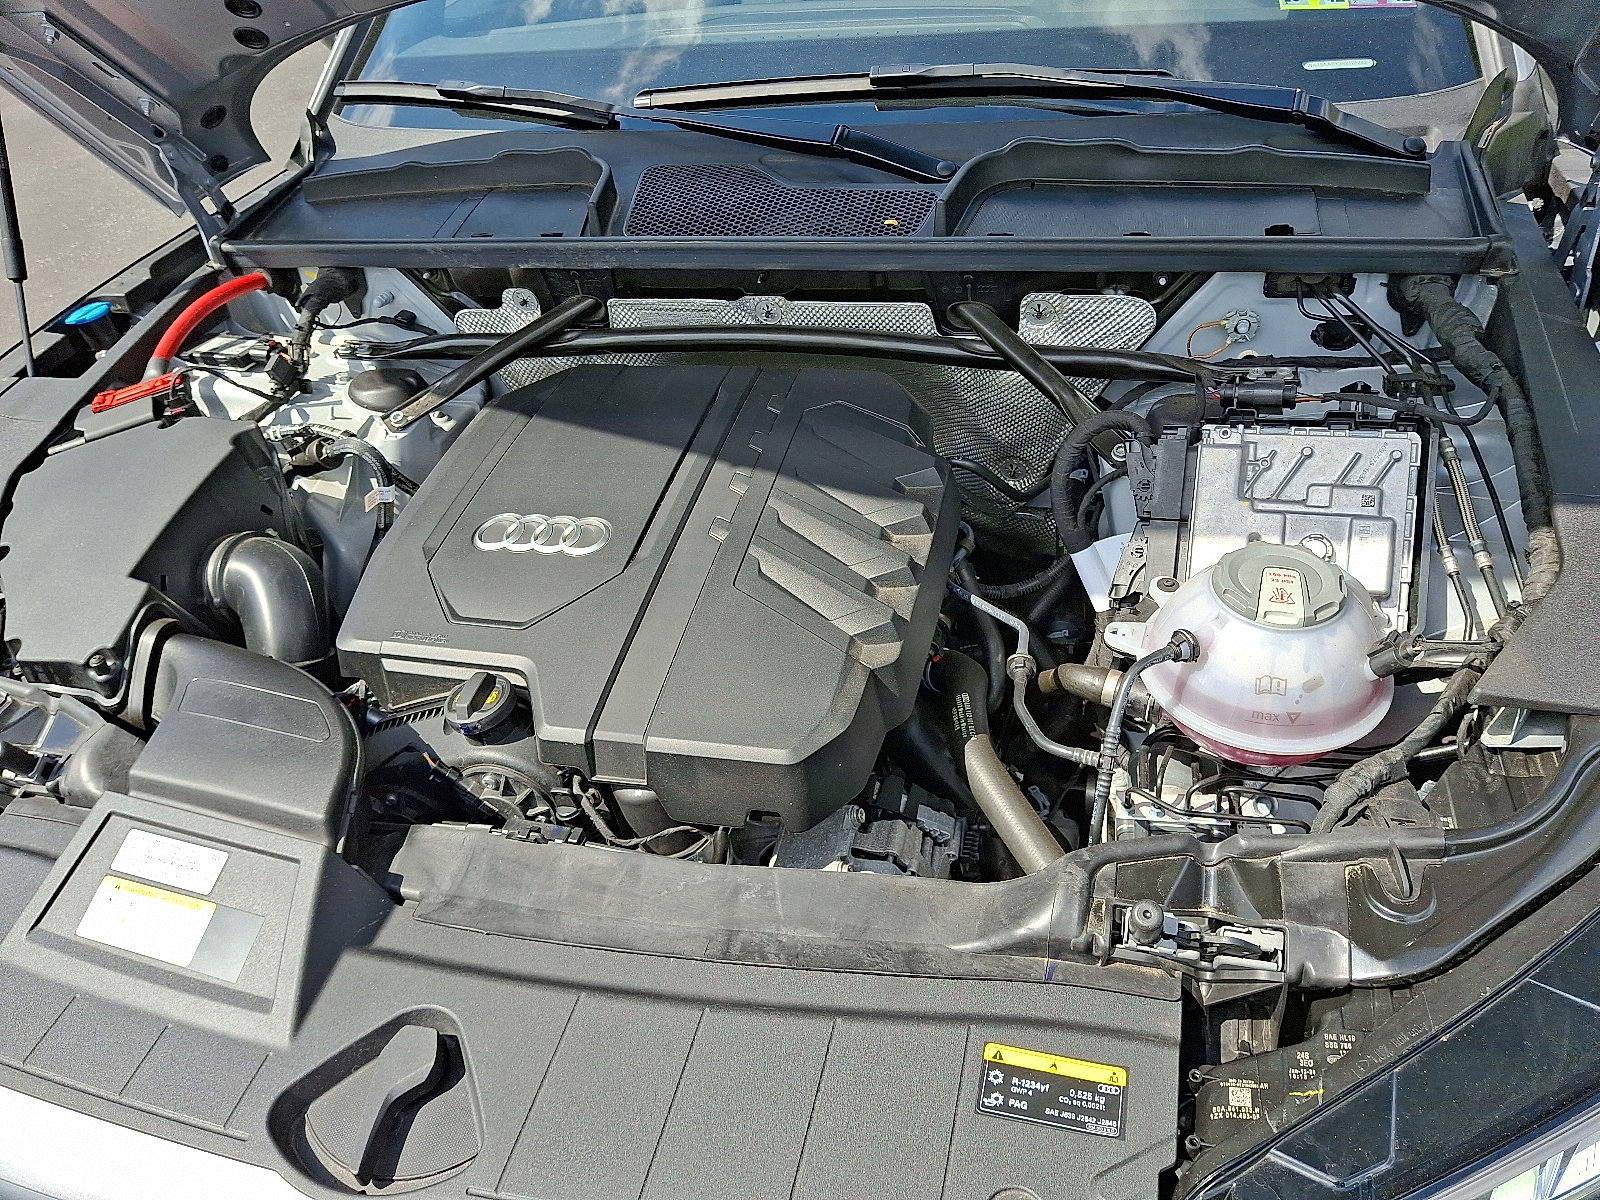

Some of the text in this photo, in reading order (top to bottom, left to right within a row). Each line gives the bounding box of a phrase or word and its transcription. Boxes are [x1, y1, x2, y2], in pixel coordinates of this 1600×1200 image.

[1251, 710, 1280, 722] max
[1011, 1076, 1050, 1093] R-1234yf
[1069, 1088, 1106, 1105] 0,525 kg
[1008, 1098, 1028, 1110] PAG
[1045, 1107, 1059, 1117] SAE
